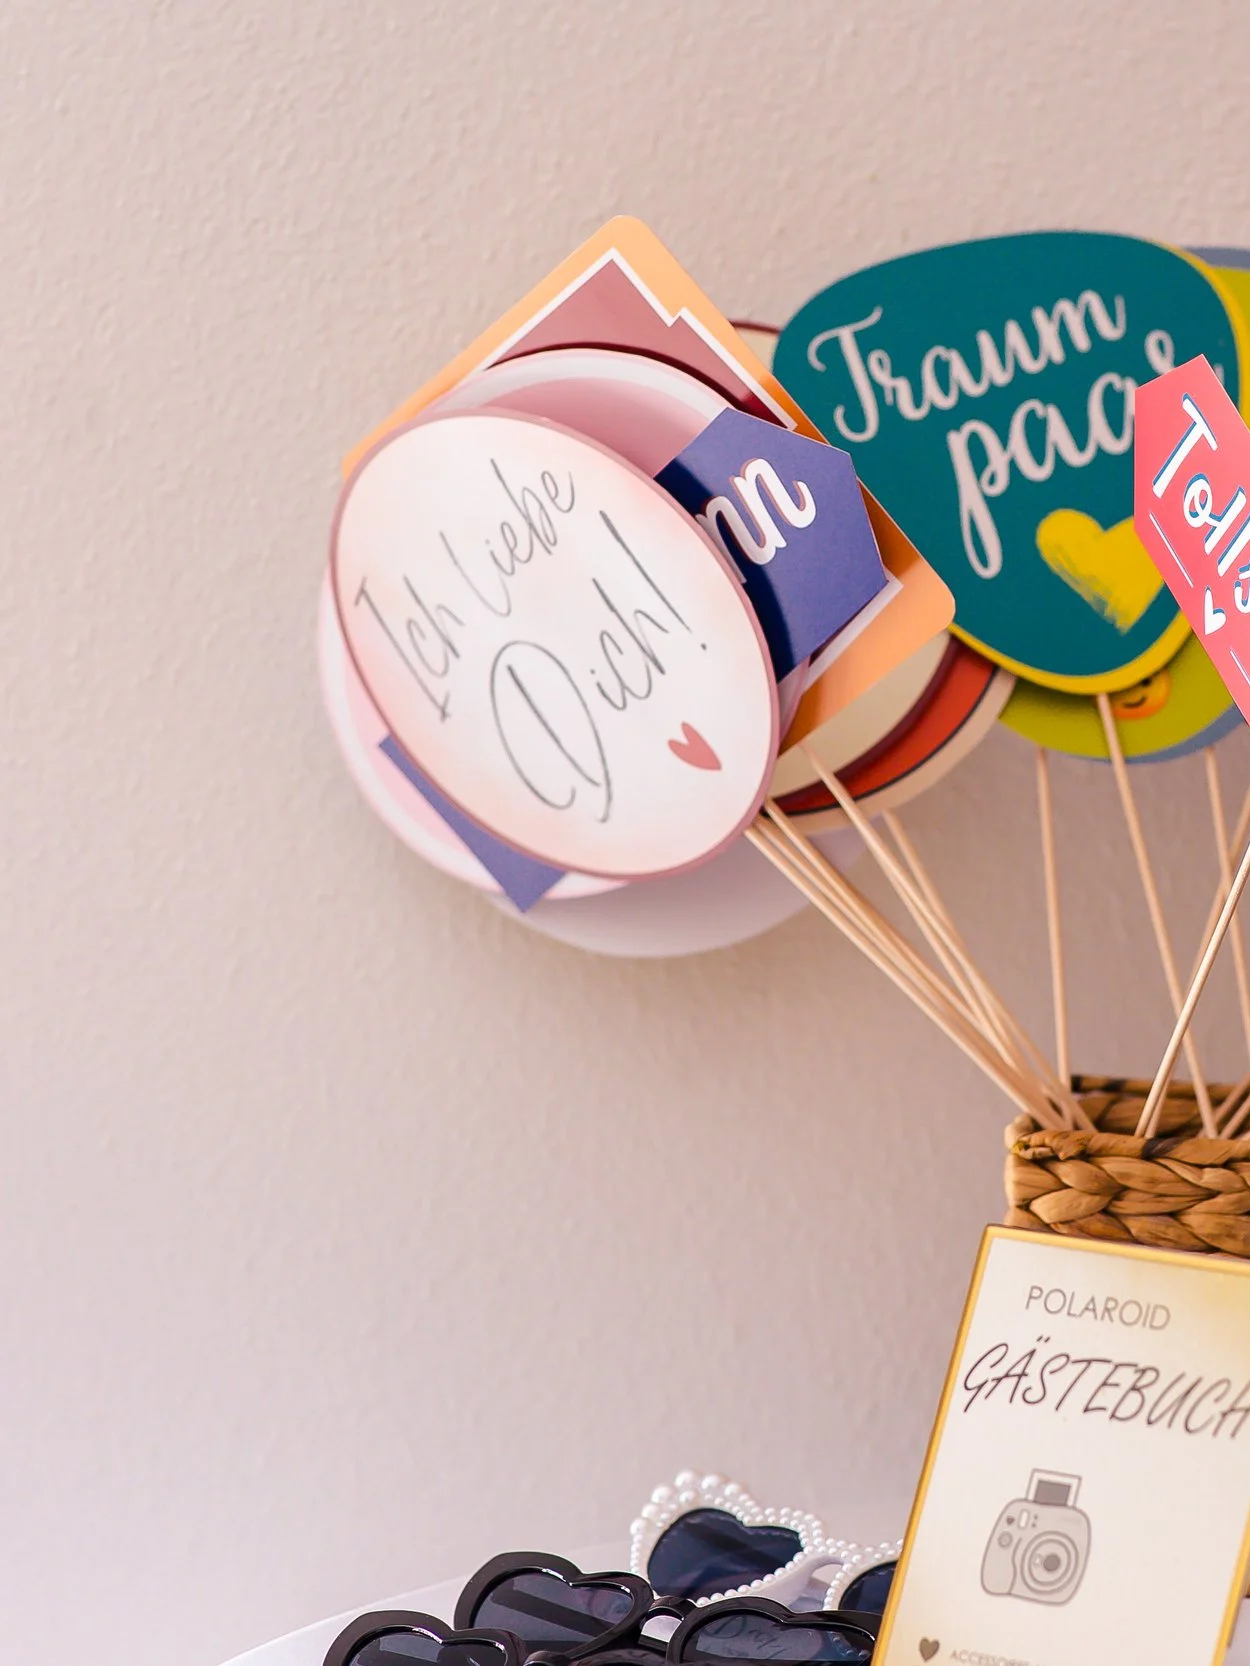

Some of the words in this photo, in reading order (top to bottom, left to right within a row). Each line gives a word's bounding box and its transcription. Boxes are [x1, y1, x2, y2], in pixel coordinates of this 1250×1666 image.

[807, 289, 1127, 442] Traum
[355, 576, 464, 722] Ich
[491, 510, 708, 823] Dich!
[1025, 1285, 1171, 1332] POLAROID
